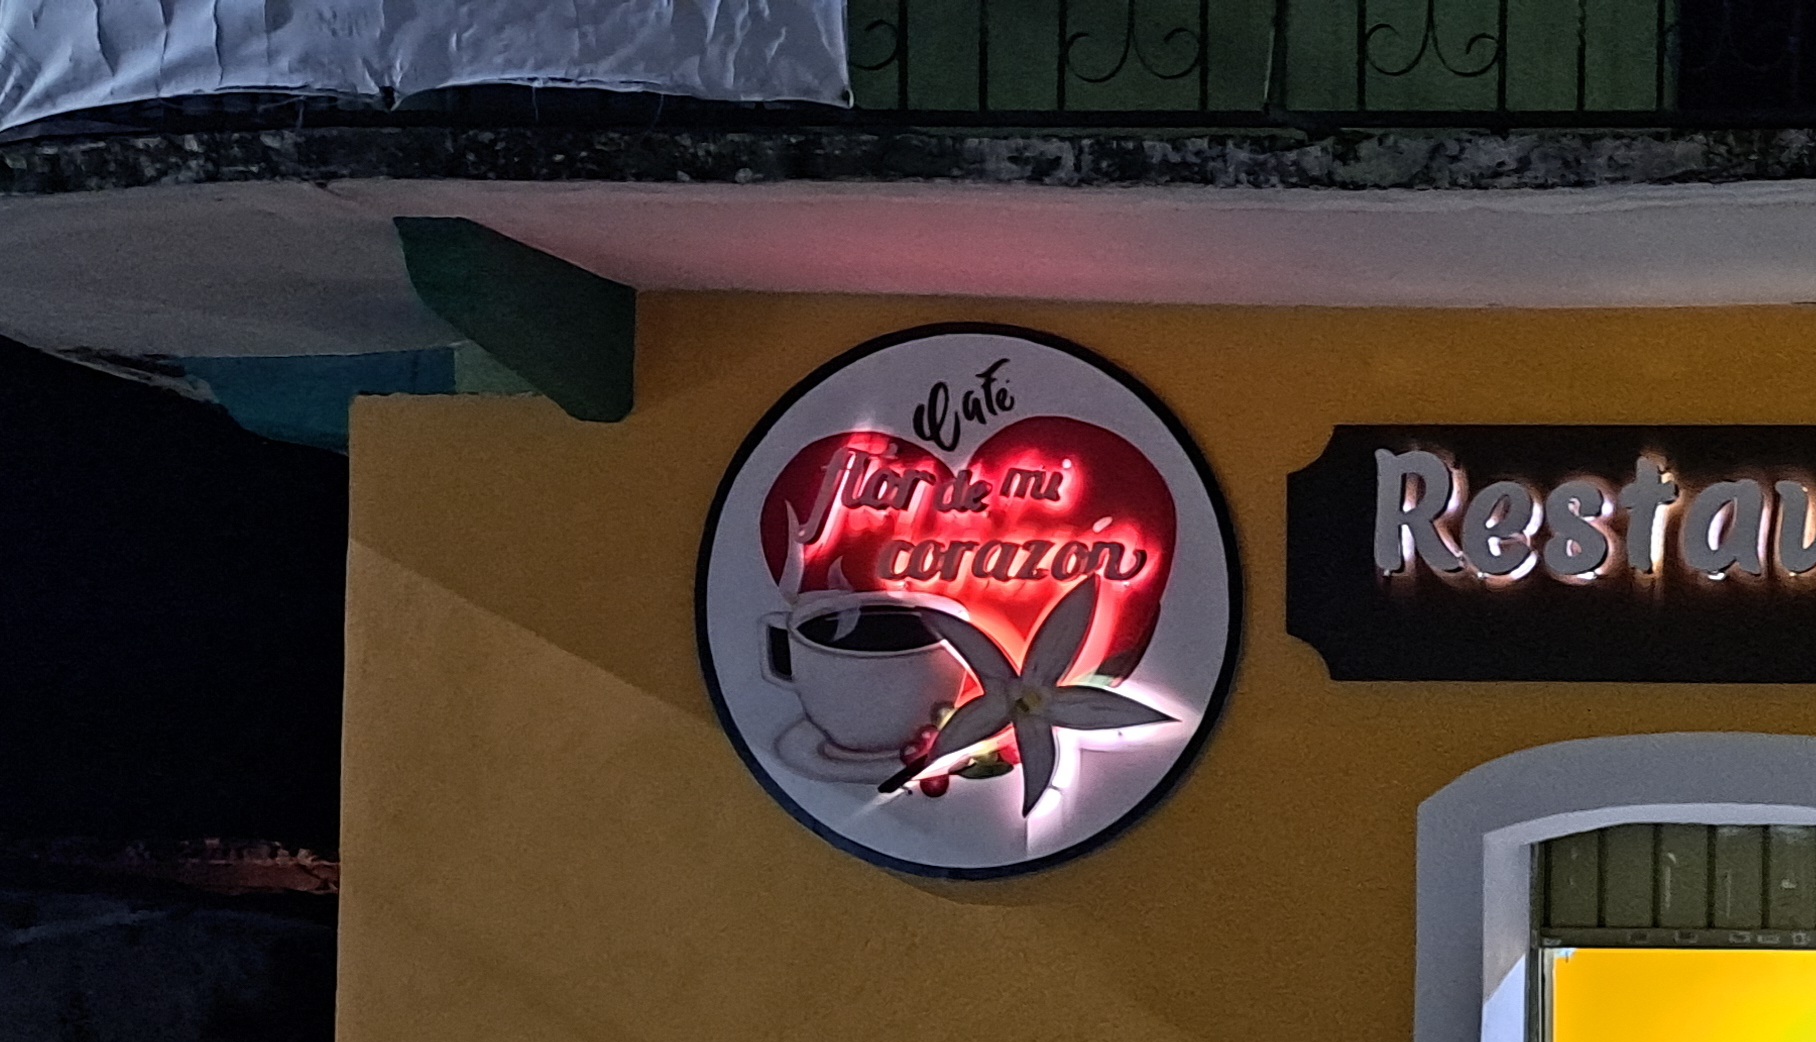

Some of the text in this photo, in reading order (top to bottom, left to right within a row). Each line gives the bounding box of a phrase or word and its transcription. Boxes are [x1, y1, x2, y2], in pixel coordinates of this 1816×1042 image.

[798, 446, 1072, 544] flor de mi
[877, 516, 1147, 582] corazón
